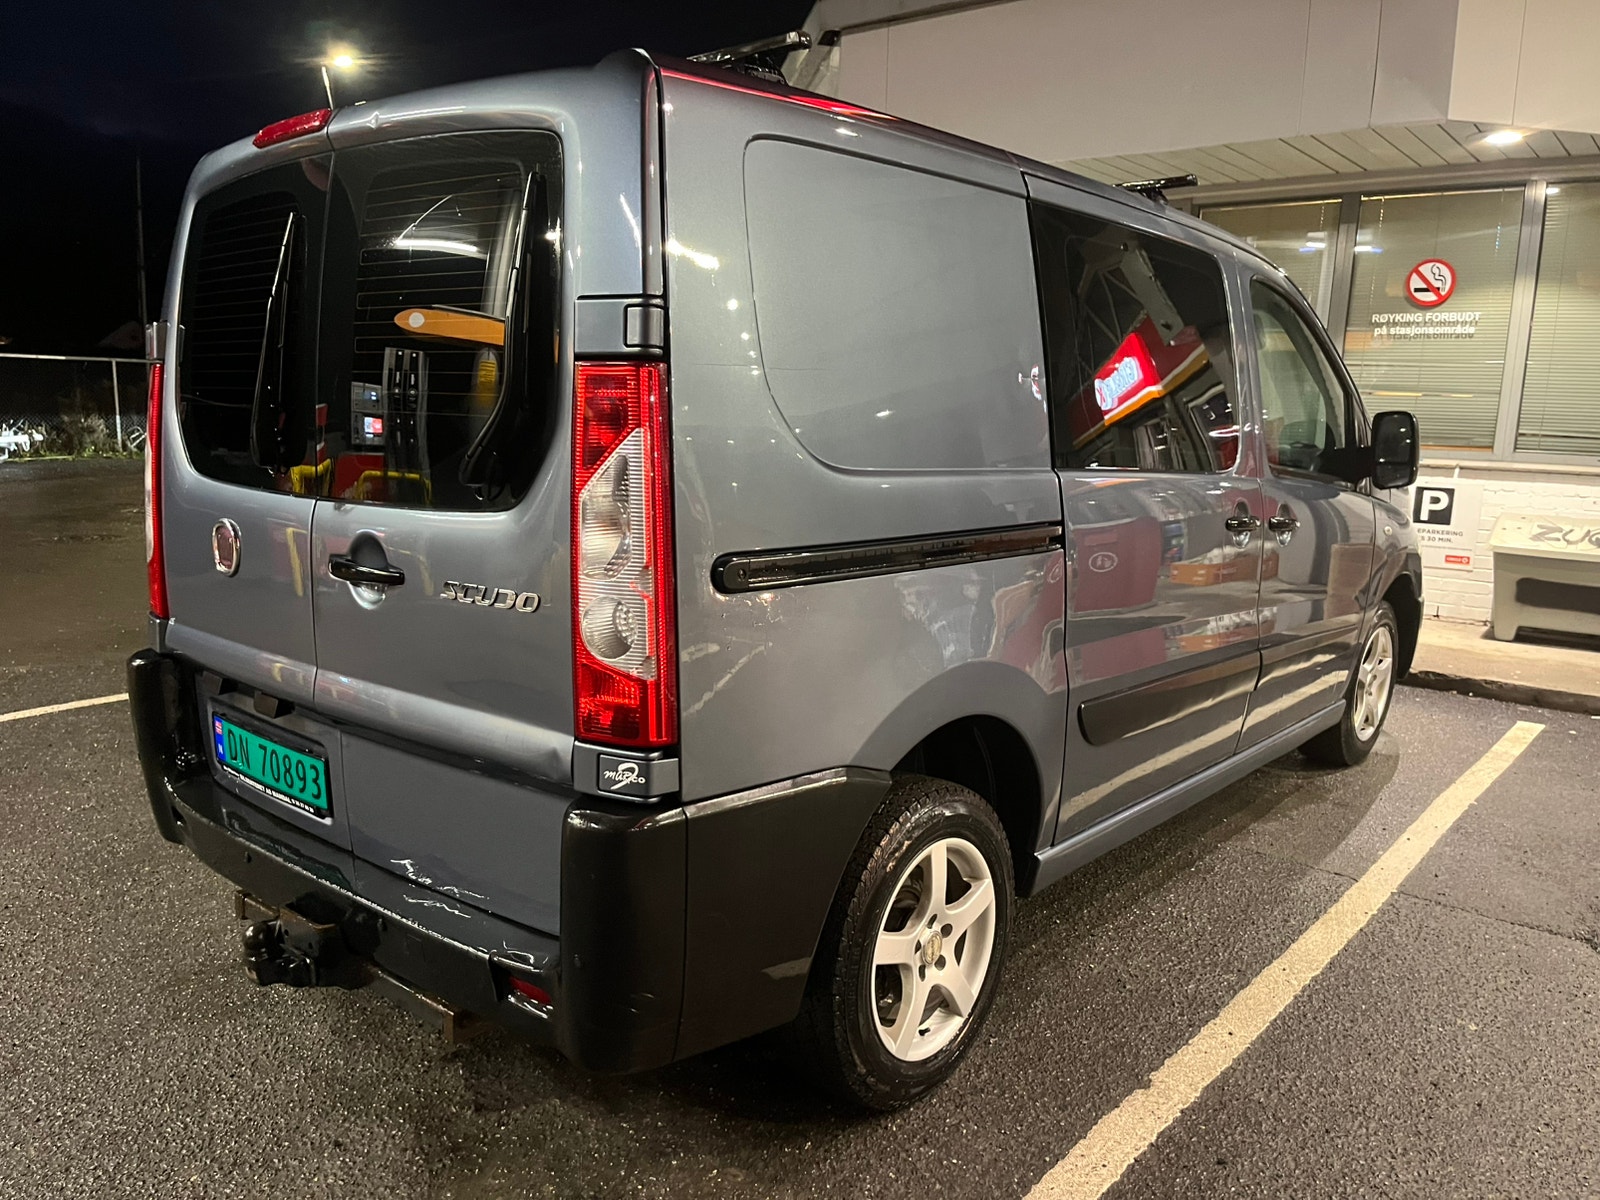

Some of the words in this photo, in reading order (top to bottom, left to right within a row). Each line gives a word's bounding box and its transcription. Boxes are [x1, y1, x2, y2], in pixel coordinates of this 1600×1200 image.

[1372, 313, 1423, 323] RØYKING
[1425, 312, 1481, 322] FORBUDT
[1374, 325, 1387, 336] på
[1389, 325, 1475, 336] stasjonsområde
[1420, 489, 1450, 521] P
[440, 580, 539, 613] SCUDO
[227, 728, 251, 770] DN
[258, 743, 322, 800] 70893
